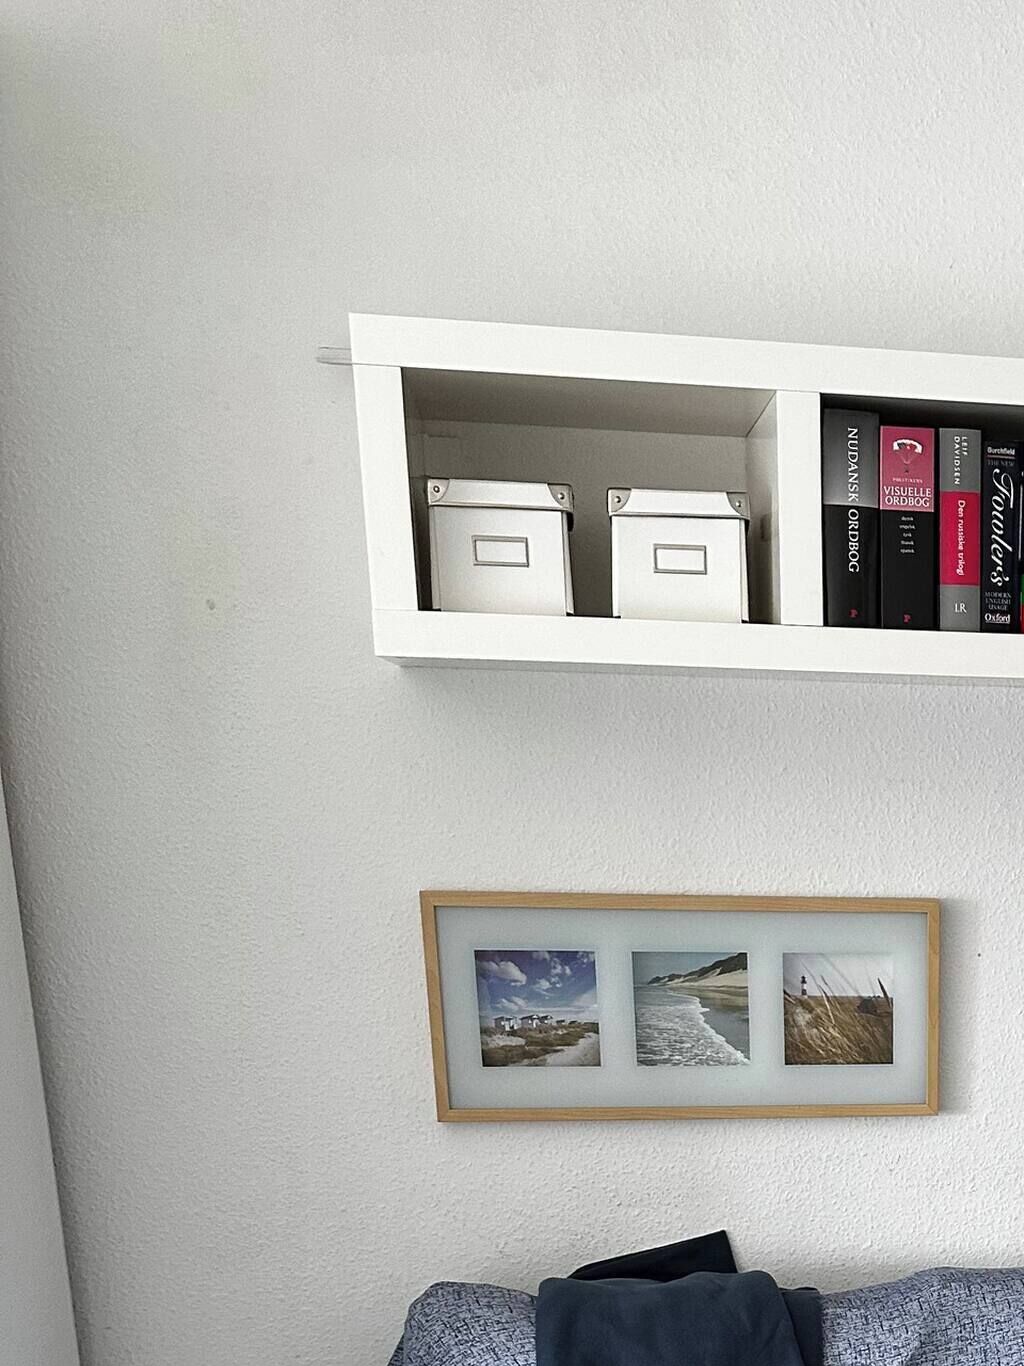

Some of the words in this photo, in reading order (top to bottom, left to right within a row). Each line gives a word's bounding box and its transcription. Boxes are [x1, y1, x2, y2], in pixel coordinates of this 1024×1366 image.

[987, 446, 1015, 456] Burchfield
[847, 427, 859, 502] NUDANSK
[883, 486, 932, 498] VISUELLE
[885, 495, 930, 507] ORDBOG
[957, 500, 966, 517] Den
[958, 519, 966, 550] russiske
[990, 468, 1014, 586] Fowler's
[848, 508, 860, 573] ORDBOG
[956, 552, 966, 576] trilogi
[984, 612, 1011, 624] Oxford
